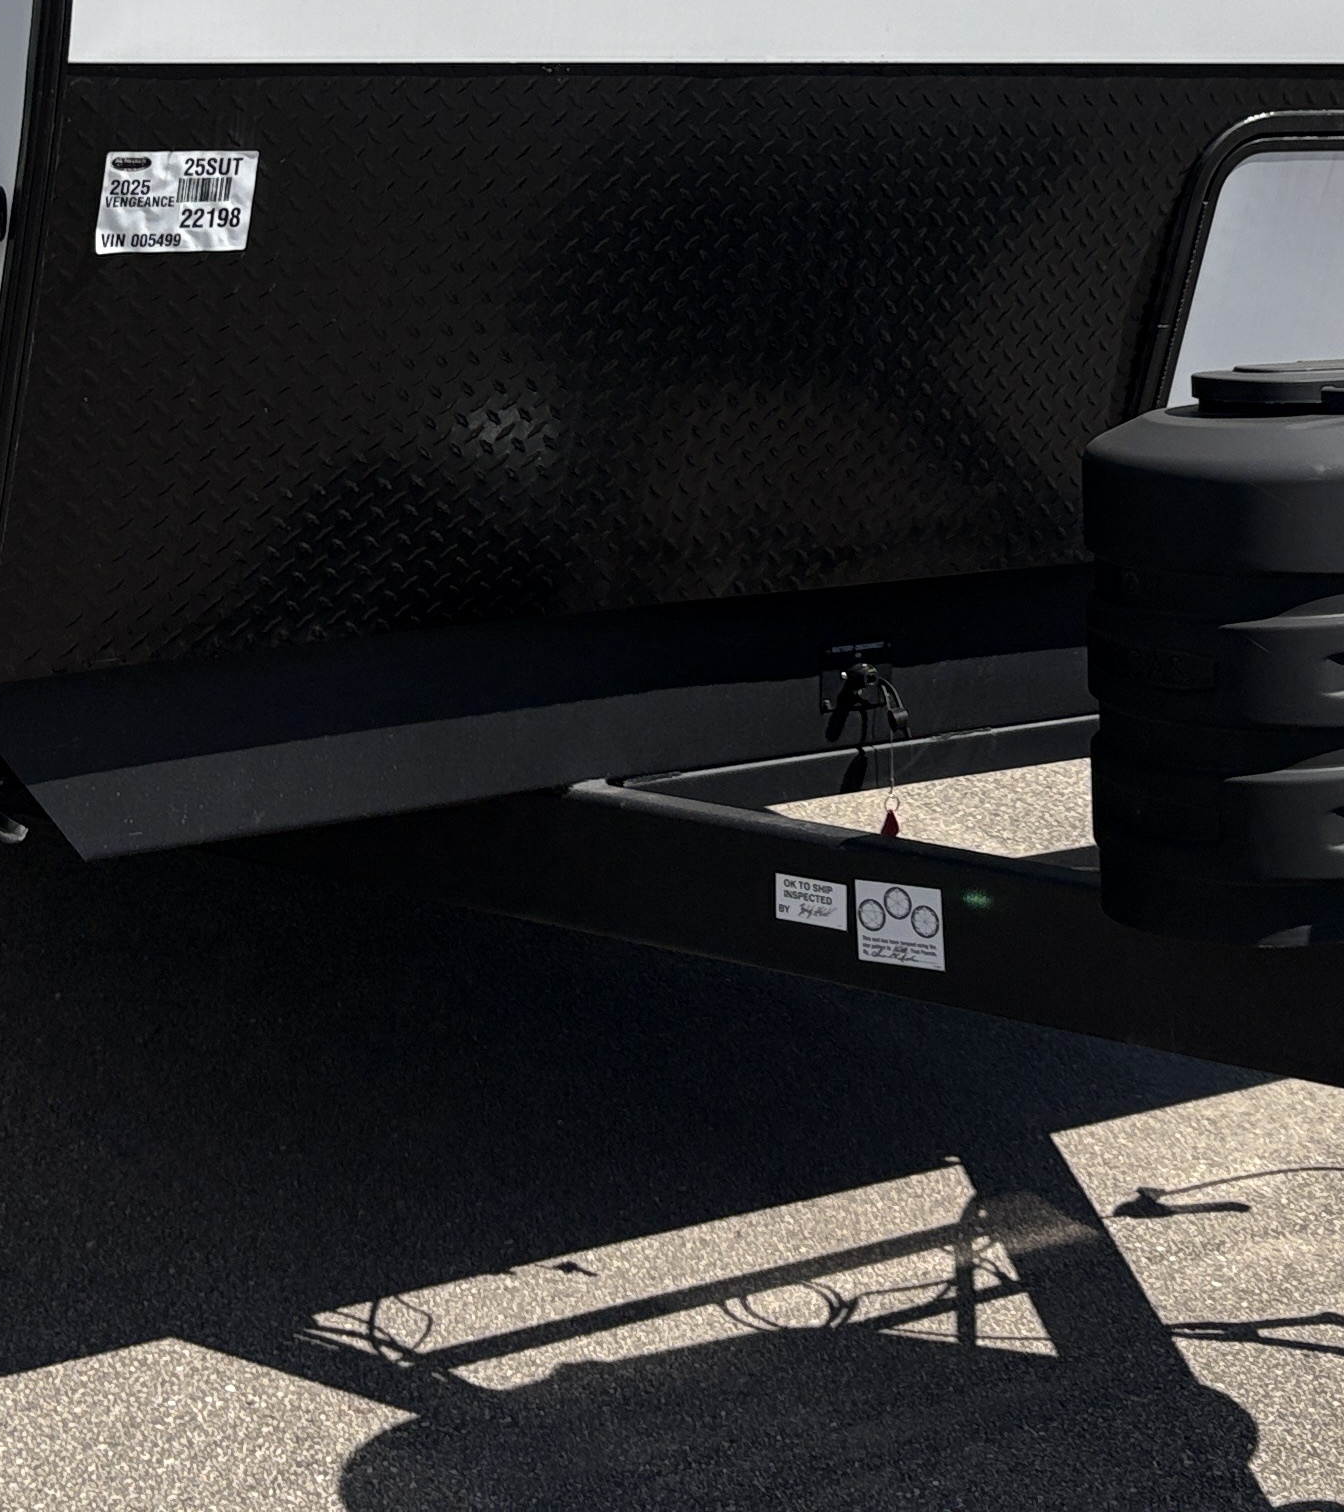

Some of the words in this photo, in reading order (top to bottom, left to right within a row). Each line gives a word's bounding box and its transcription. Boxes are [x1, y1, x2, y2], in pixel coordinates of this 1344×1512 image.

[183, 157, 244, 177] 25SUT
[109, 179, 152, 196] 2025
[105, 196, 175, 208] VENGEANCE
[179, 207, 242, 229] 22198
[101, 233, 127, 248] VIN
[131, 233, 182, 248] 005499
[783, 878, 798, 890] OK
[798, 880, 811, 891] TO
[783, 889, 833, 906] INSPECTED
